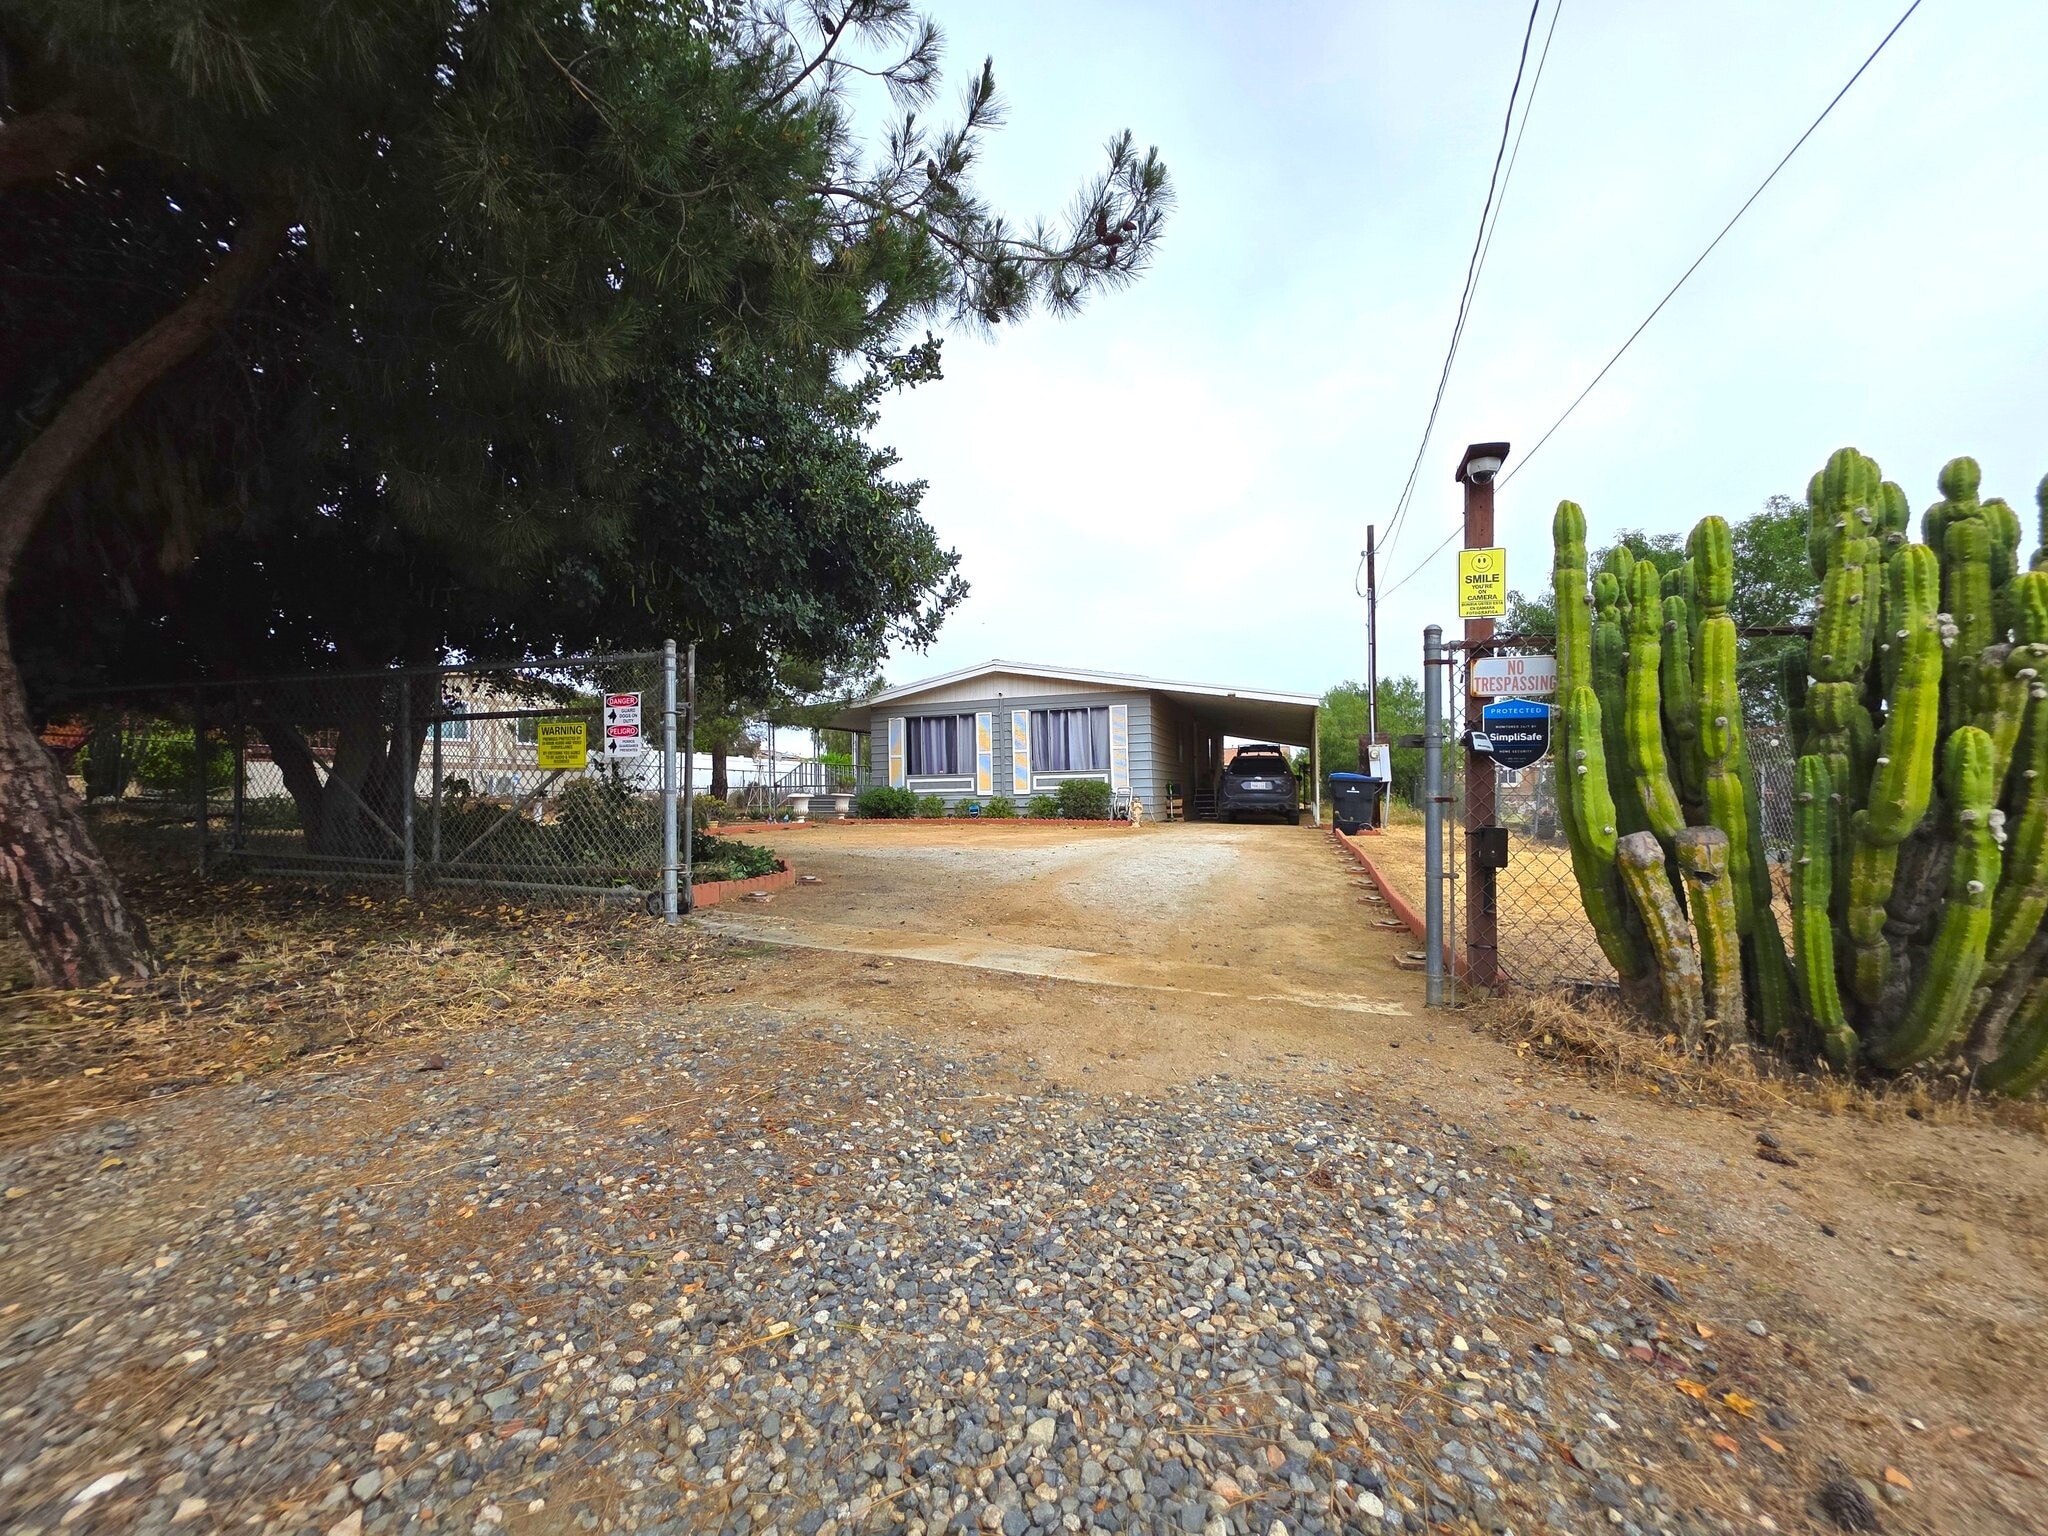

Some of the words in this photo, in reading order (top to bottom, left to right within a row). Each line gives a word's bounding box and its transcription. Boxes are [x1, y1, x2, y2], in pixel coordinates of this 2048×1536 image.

[1465, 574, 1500, 584] SMILE
[1507, 660, 1524, 675] NO
[1474, 676, 1557, 692] TRESPASSING
[542, 726, 582, 735] WARNING
[1490, 733, 1542, 742] SimpliSafe
